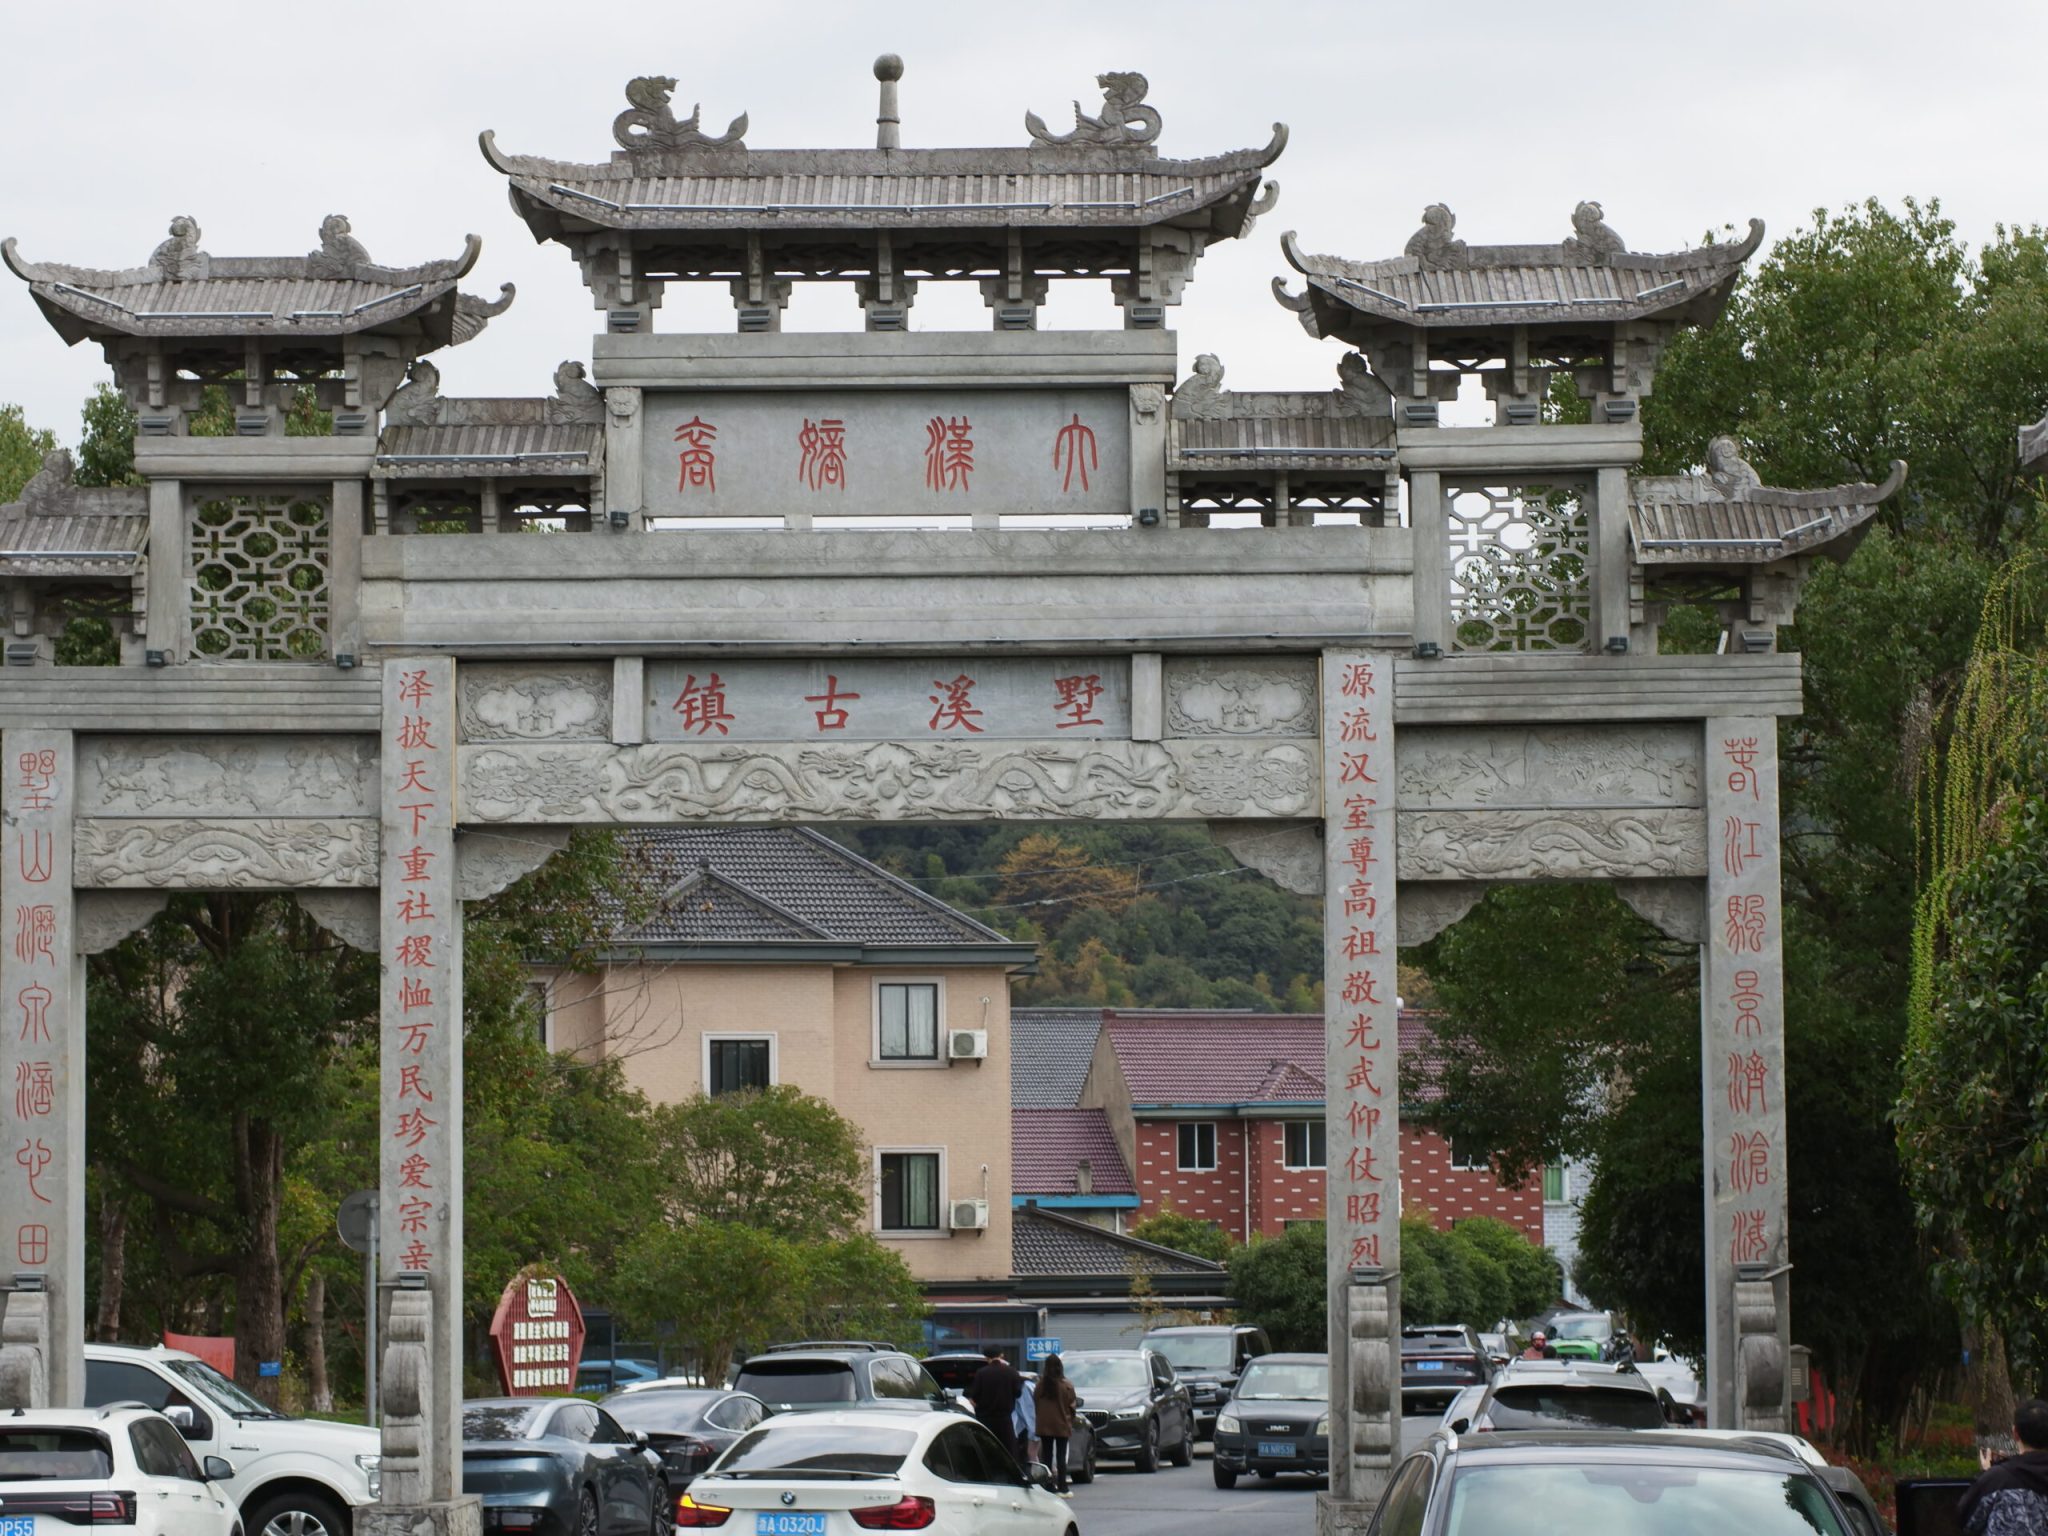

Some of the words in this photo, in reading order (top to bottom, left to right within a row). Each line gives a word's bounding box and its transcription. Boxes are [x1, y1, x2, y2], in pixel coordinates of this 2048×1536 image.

[1339, 663, 1382, 1272] 源流汉室尊高祖敬光武仰仗昭烈
[1029, 1340, 1059, 1352] 大众餐厅
[1265, 1424, 1290, 1432] JMC
